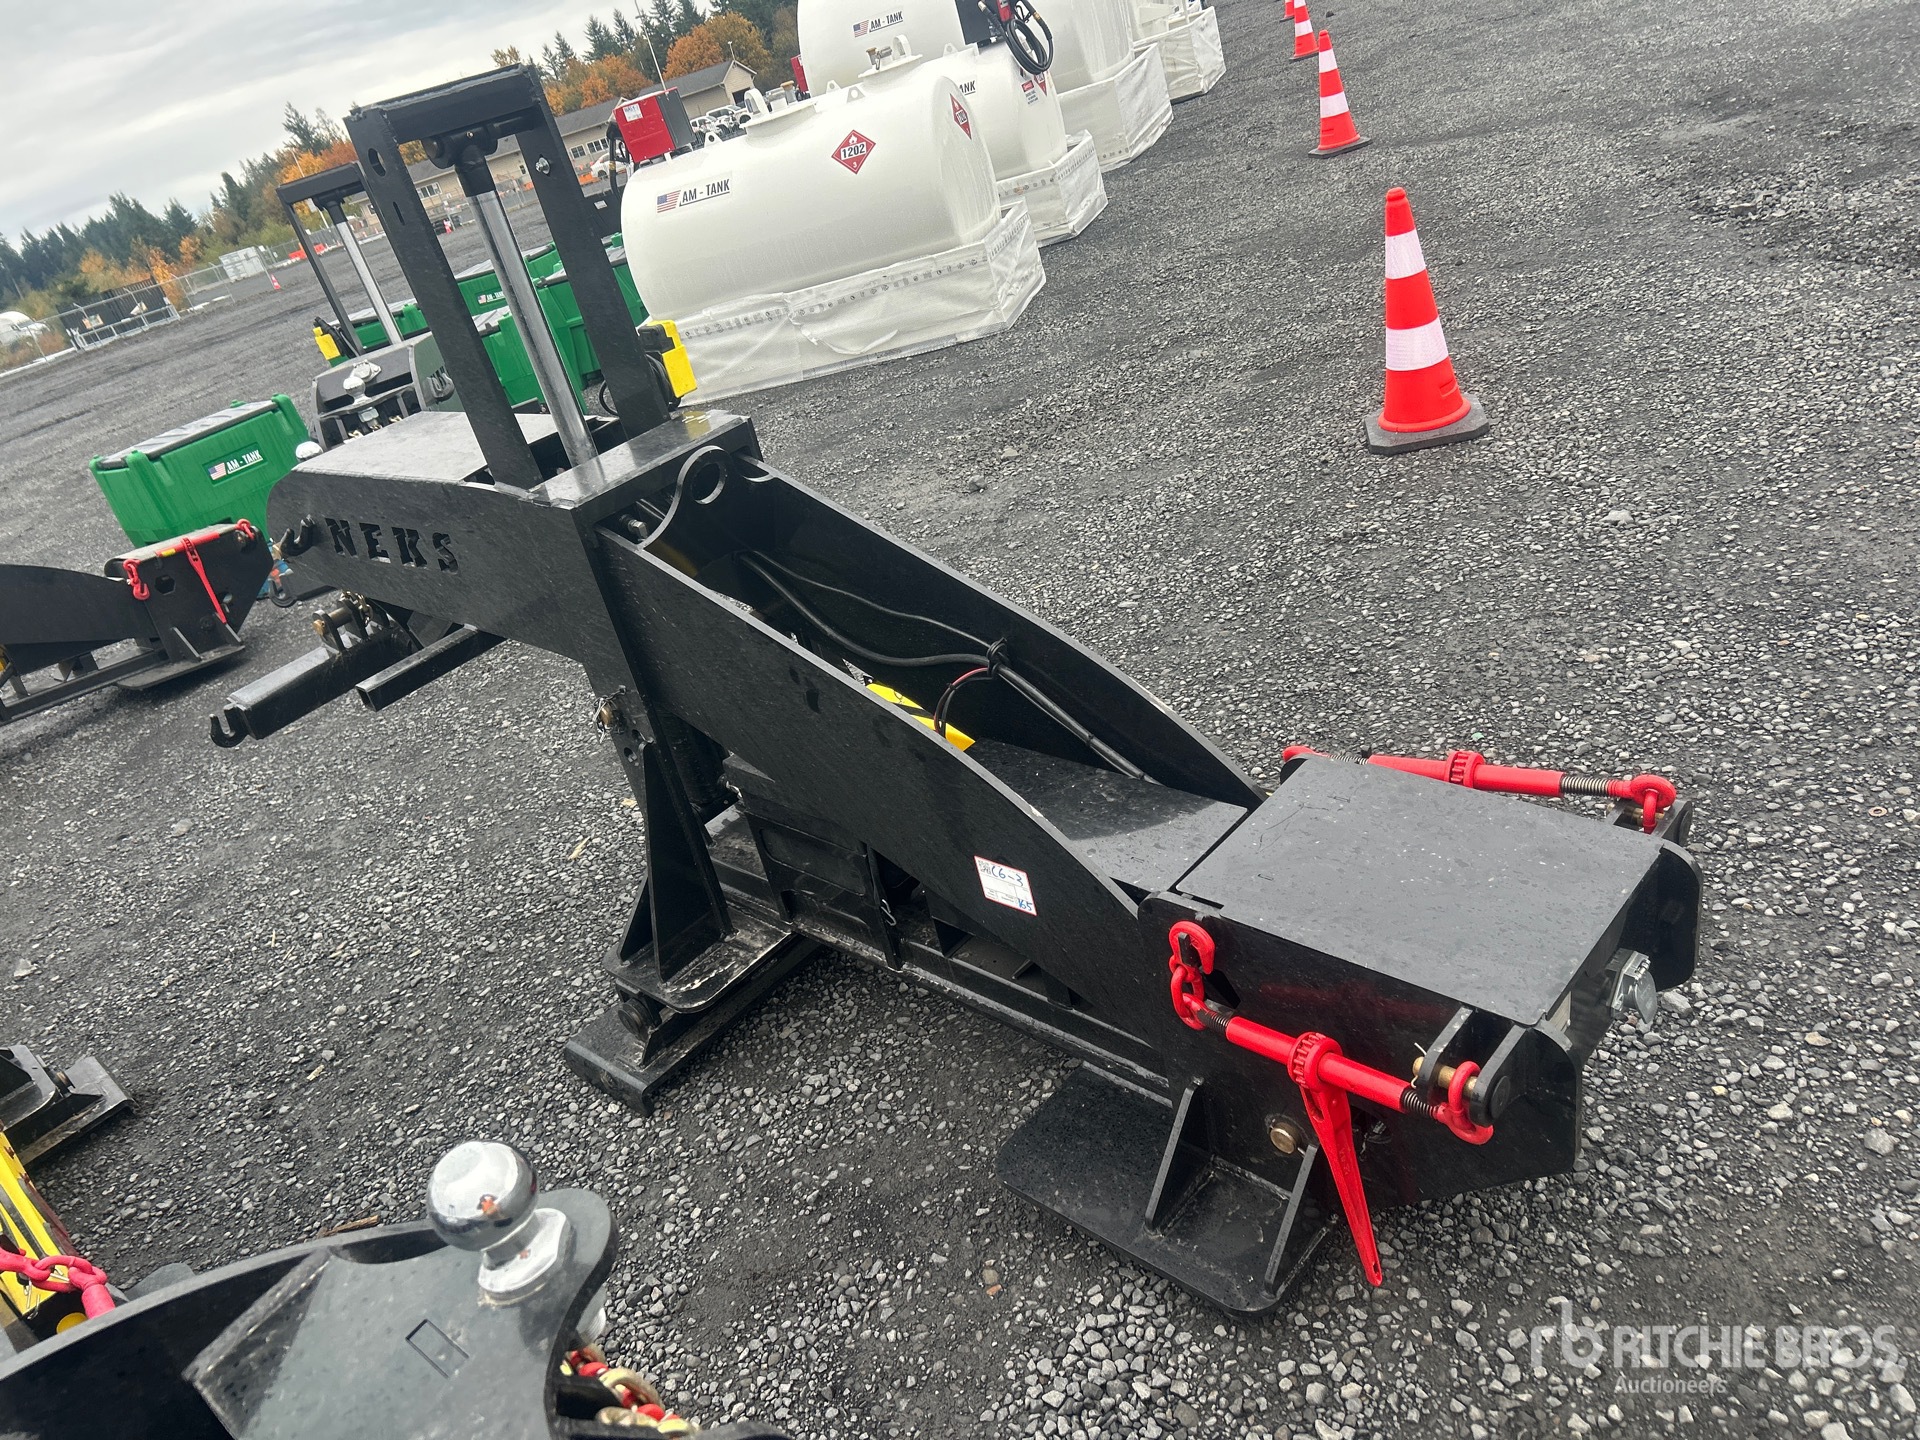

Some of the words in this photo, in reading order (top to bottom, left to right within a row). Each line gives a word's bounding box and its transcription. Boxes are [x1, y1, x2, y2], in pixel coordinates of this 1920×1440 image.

[870, 18, 881, 30] AM
[886, 11, 903, 24] TANK
[842, 143, 866, 159] 1202
[682, 188, 697, 203] AM
[706, 178, 730, 196] TANK
[226, 458, 241, 472] AM
[241, 449, 262, 464] TANK
